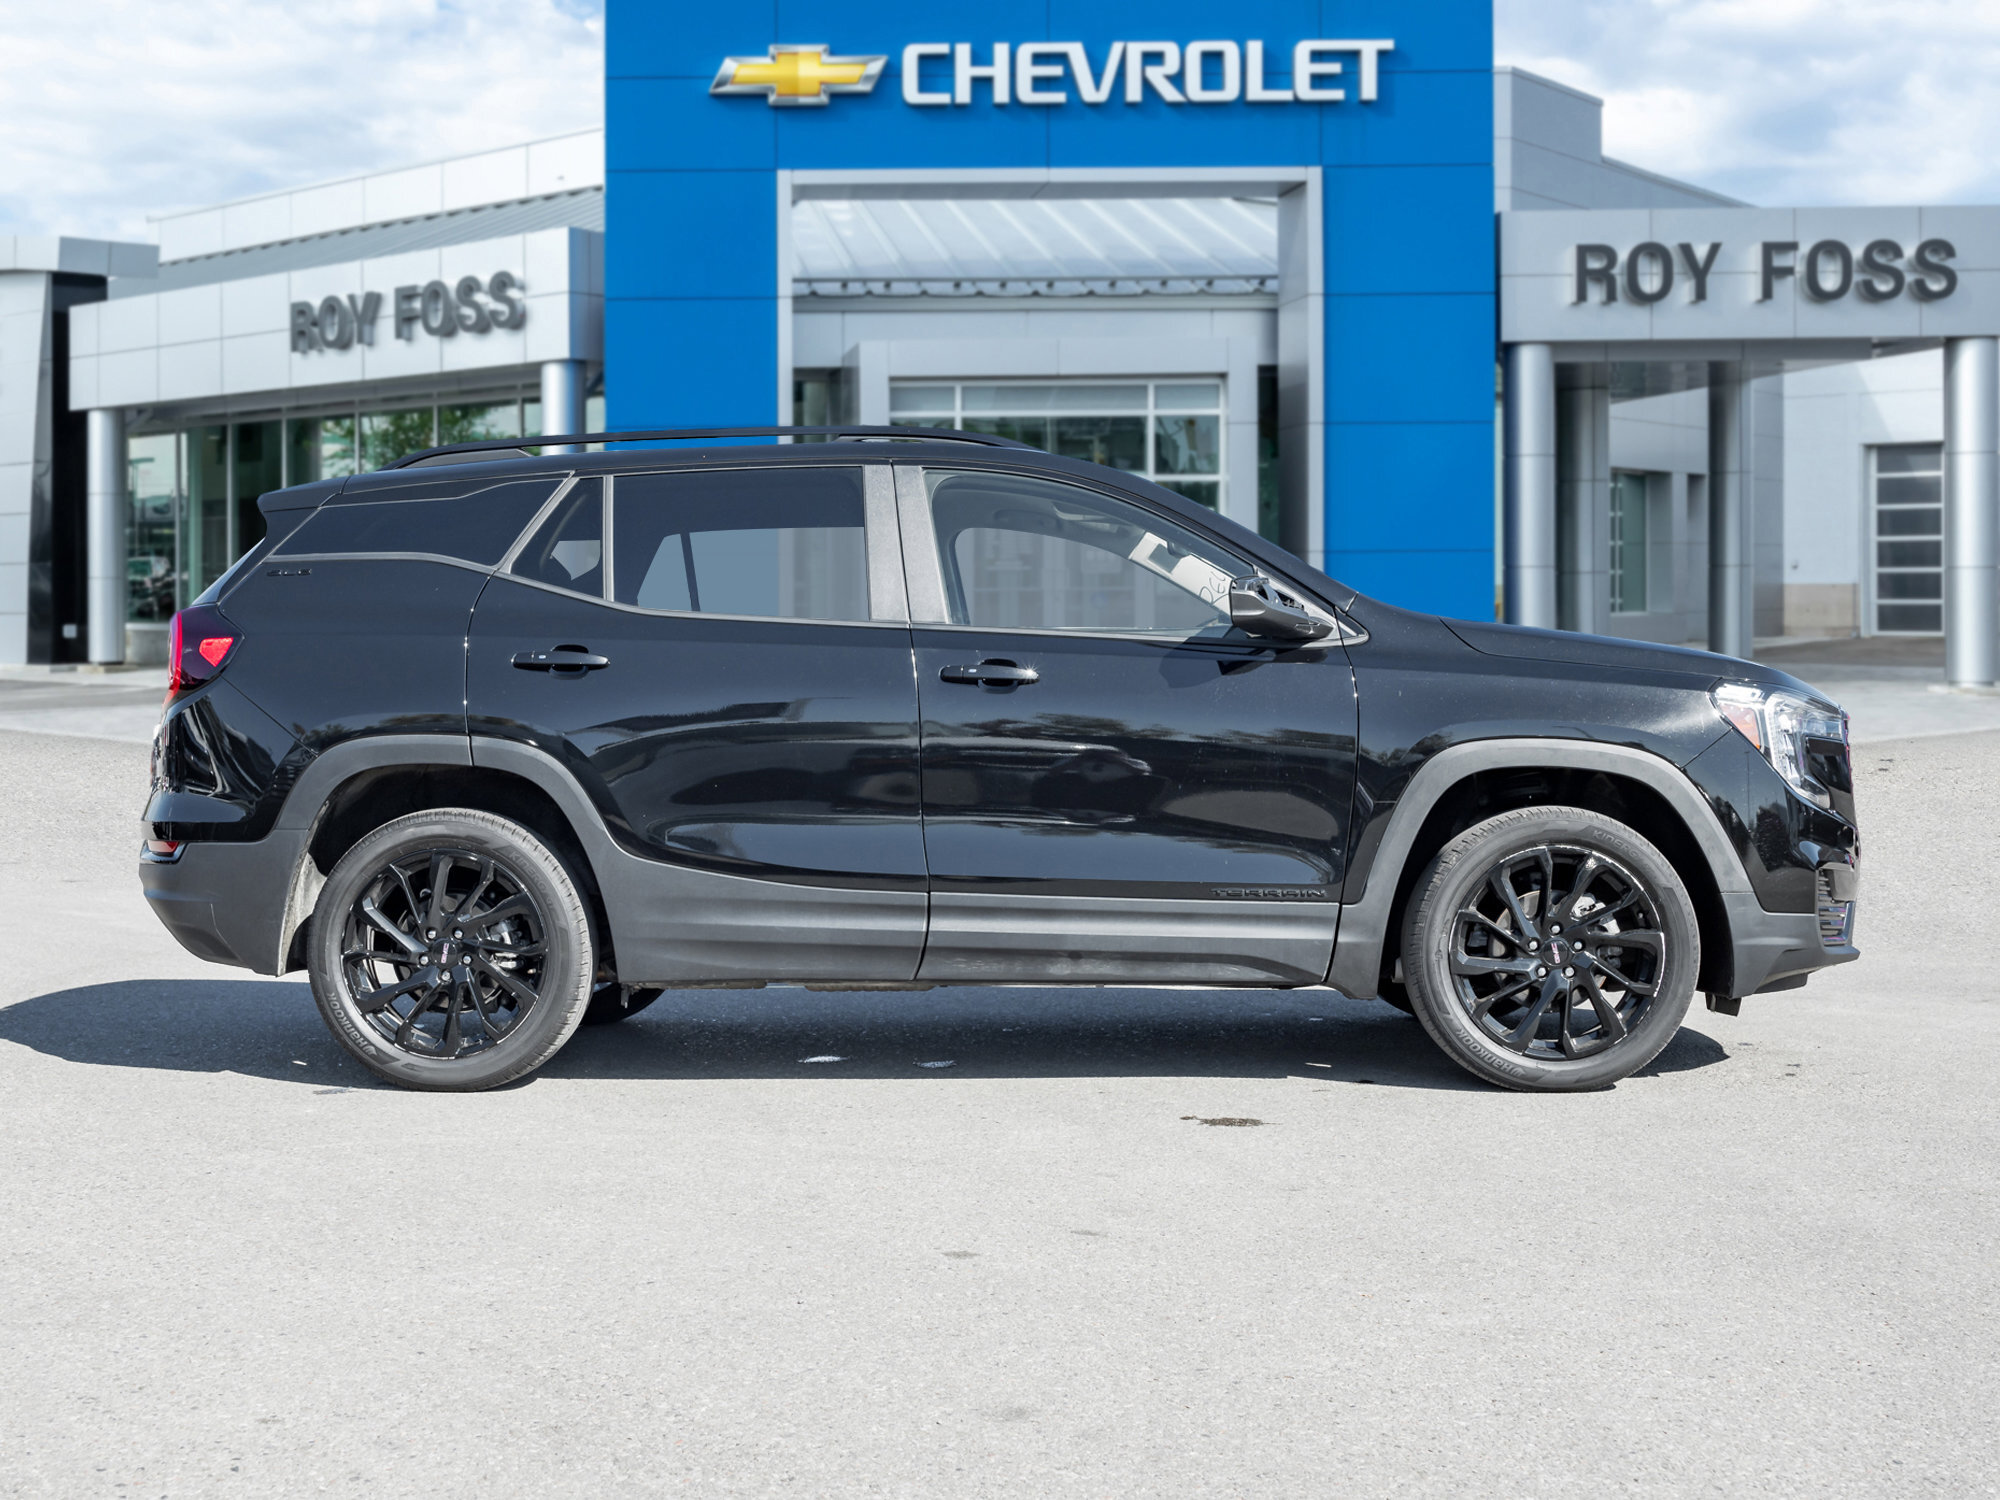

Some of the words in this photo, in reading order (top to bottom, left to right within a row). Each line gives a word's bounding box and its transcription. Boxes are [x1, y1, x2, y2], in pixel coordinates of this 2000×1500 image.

[902, 38, 1395, 106] CHEVROLET
[1570, 241, 1722, 304] ROY
[1757, 238, 1959, 303] FOSS
[290, 291, 383, 353] ROY
[394, 270, 526, 341] FOSS
[1210, 887, 1328, 899] TERRAIN
